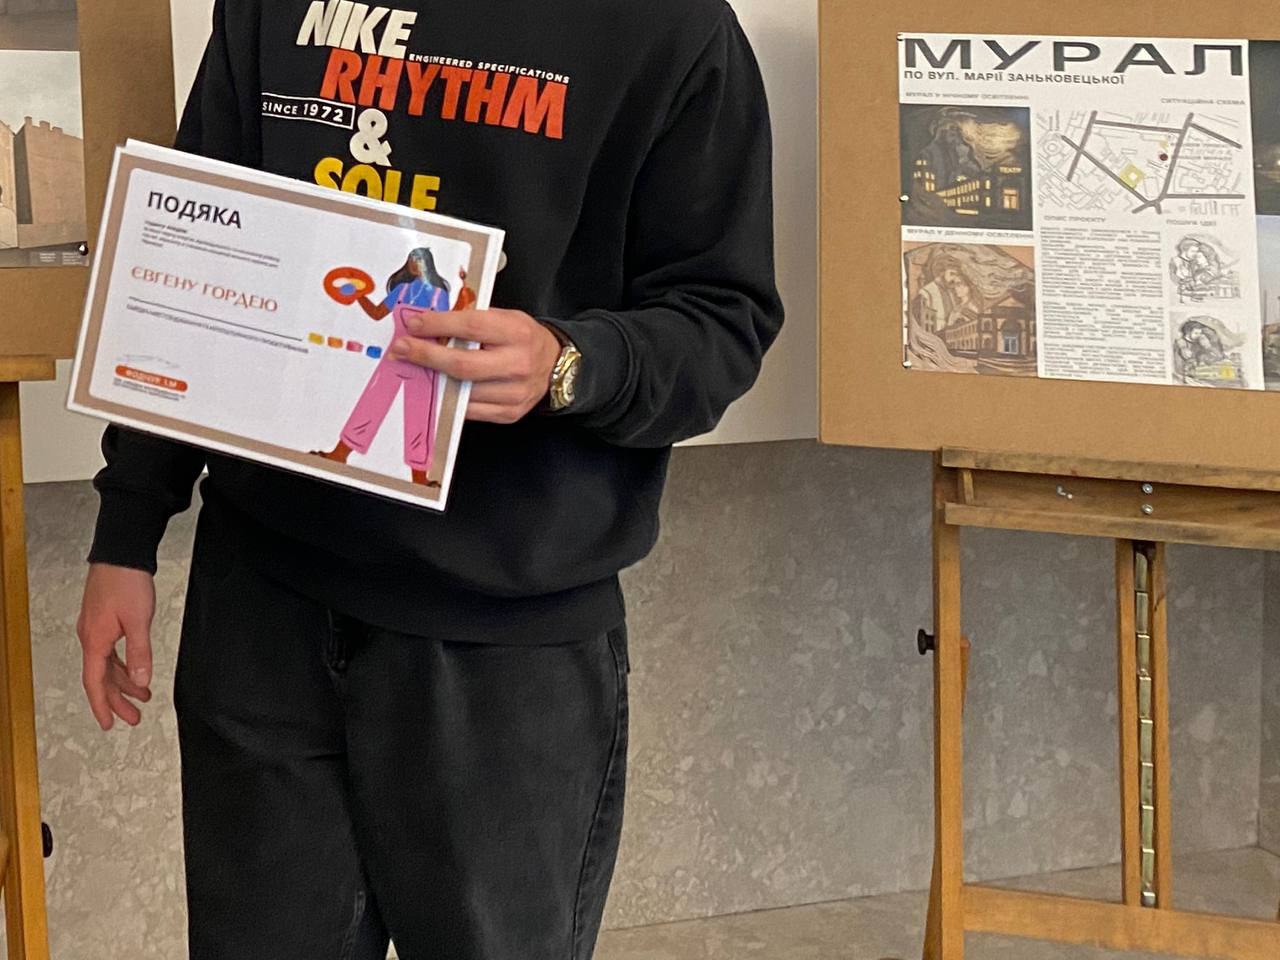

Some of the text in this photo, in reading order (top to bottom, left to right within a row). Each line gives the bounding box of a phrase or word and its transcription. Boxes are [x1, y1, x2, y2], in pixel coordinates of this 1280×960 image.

[409, 53, 570, 84] ENGINEERED SPECIFICATIONS
[905, 38, 1243, 76] МУРАЛ
[320, 48, 568, 140] RHYTHM
[904, 71, 1125, 85] ПО ВУЛ. МАРІЇ ЗАНЬКОВЕЦЬКОЇ
[261, 101, 344, 123] SINCE 1972
[349, 108, 392, 166] &
[148, 191, 242, 230] ПОДЯКА
[131, 265, 279, 313] ЄВГЕНУ ГОРДЕЮ
